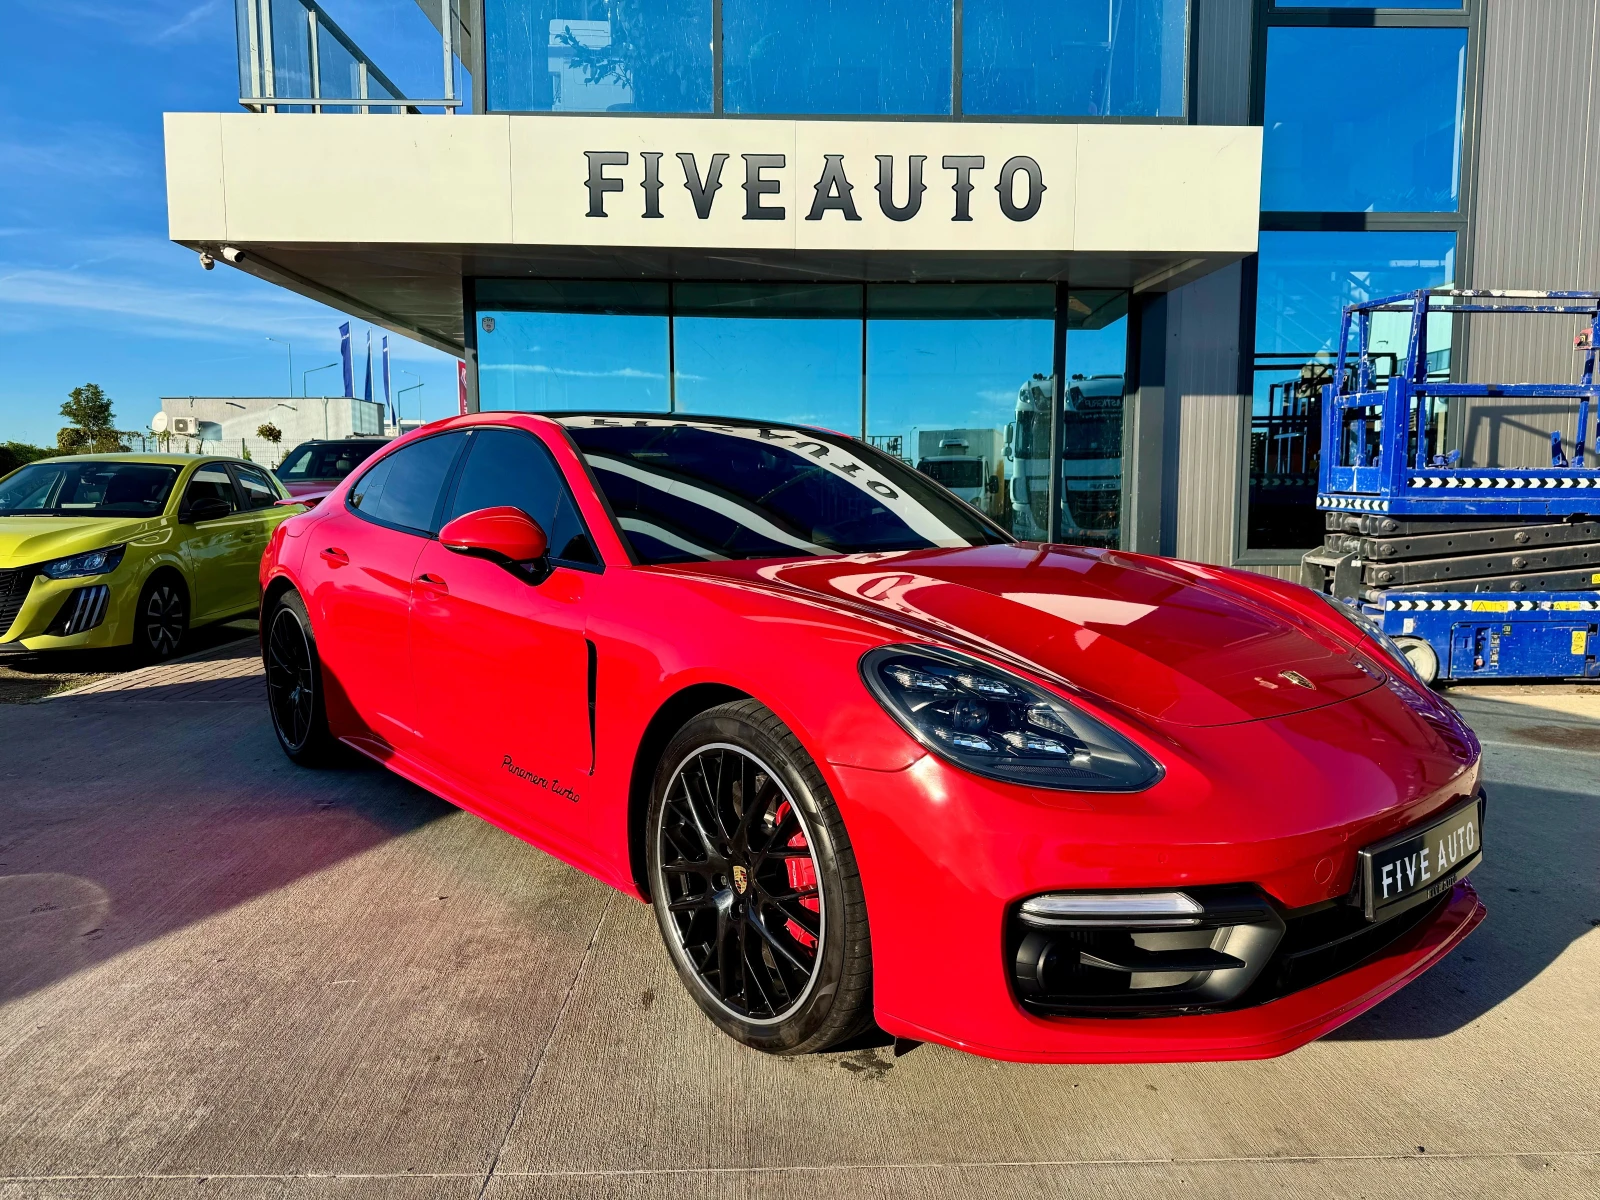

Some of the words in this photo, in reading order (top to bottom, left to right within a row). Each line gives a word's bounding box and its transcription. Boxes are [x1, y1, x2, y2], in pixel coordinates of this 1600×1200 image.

[501, 754, 549, 790] Panamera
[1381, 847, 1431, 899] FIVE
[1437, 821, 1475, 873] AUTO
